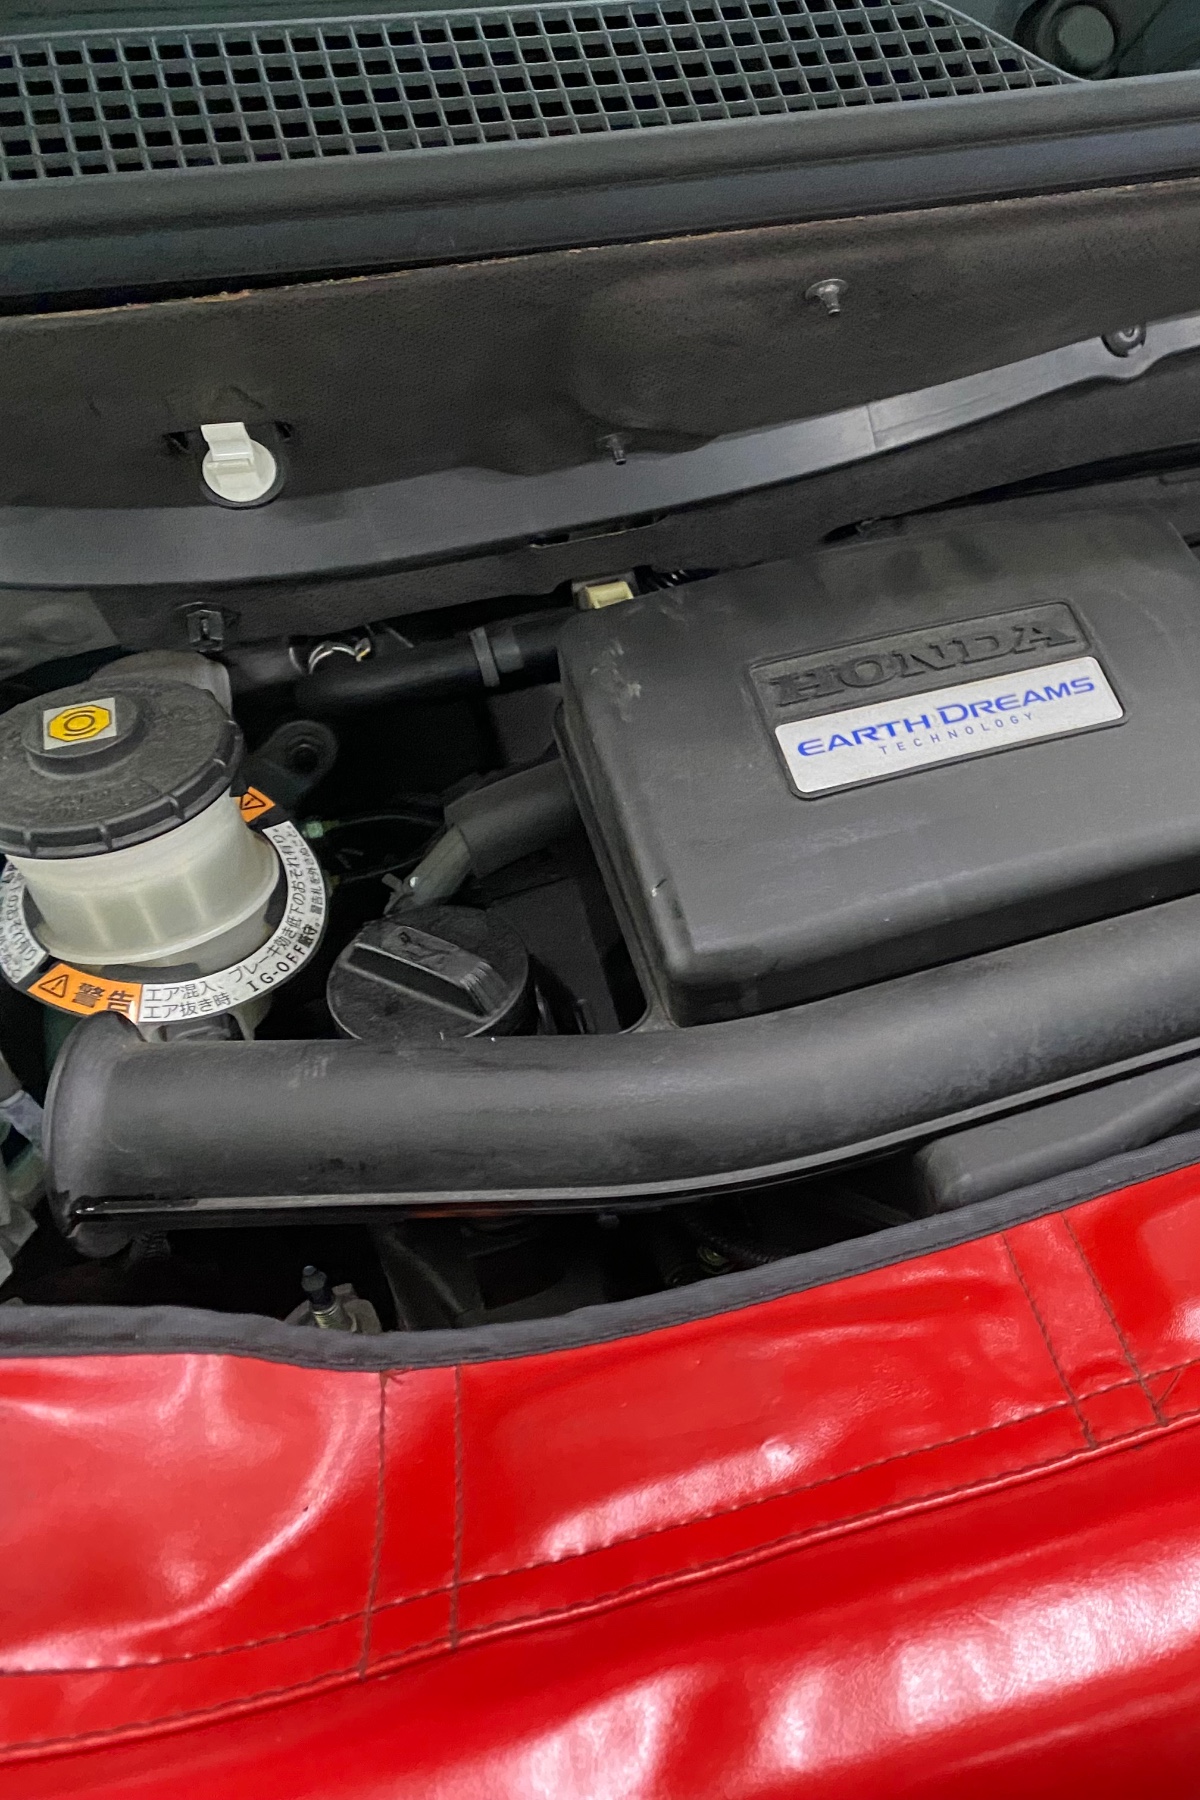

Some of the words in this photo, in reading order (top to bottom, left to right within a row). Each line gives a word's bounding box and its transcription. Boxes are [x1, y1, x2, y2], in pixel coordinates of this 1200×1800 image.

[769, 623, 1076, 708] HONDA
[797, 714, 932, 757] EARTH
[881, 711, 1034, 755] TECHNOLOGY
